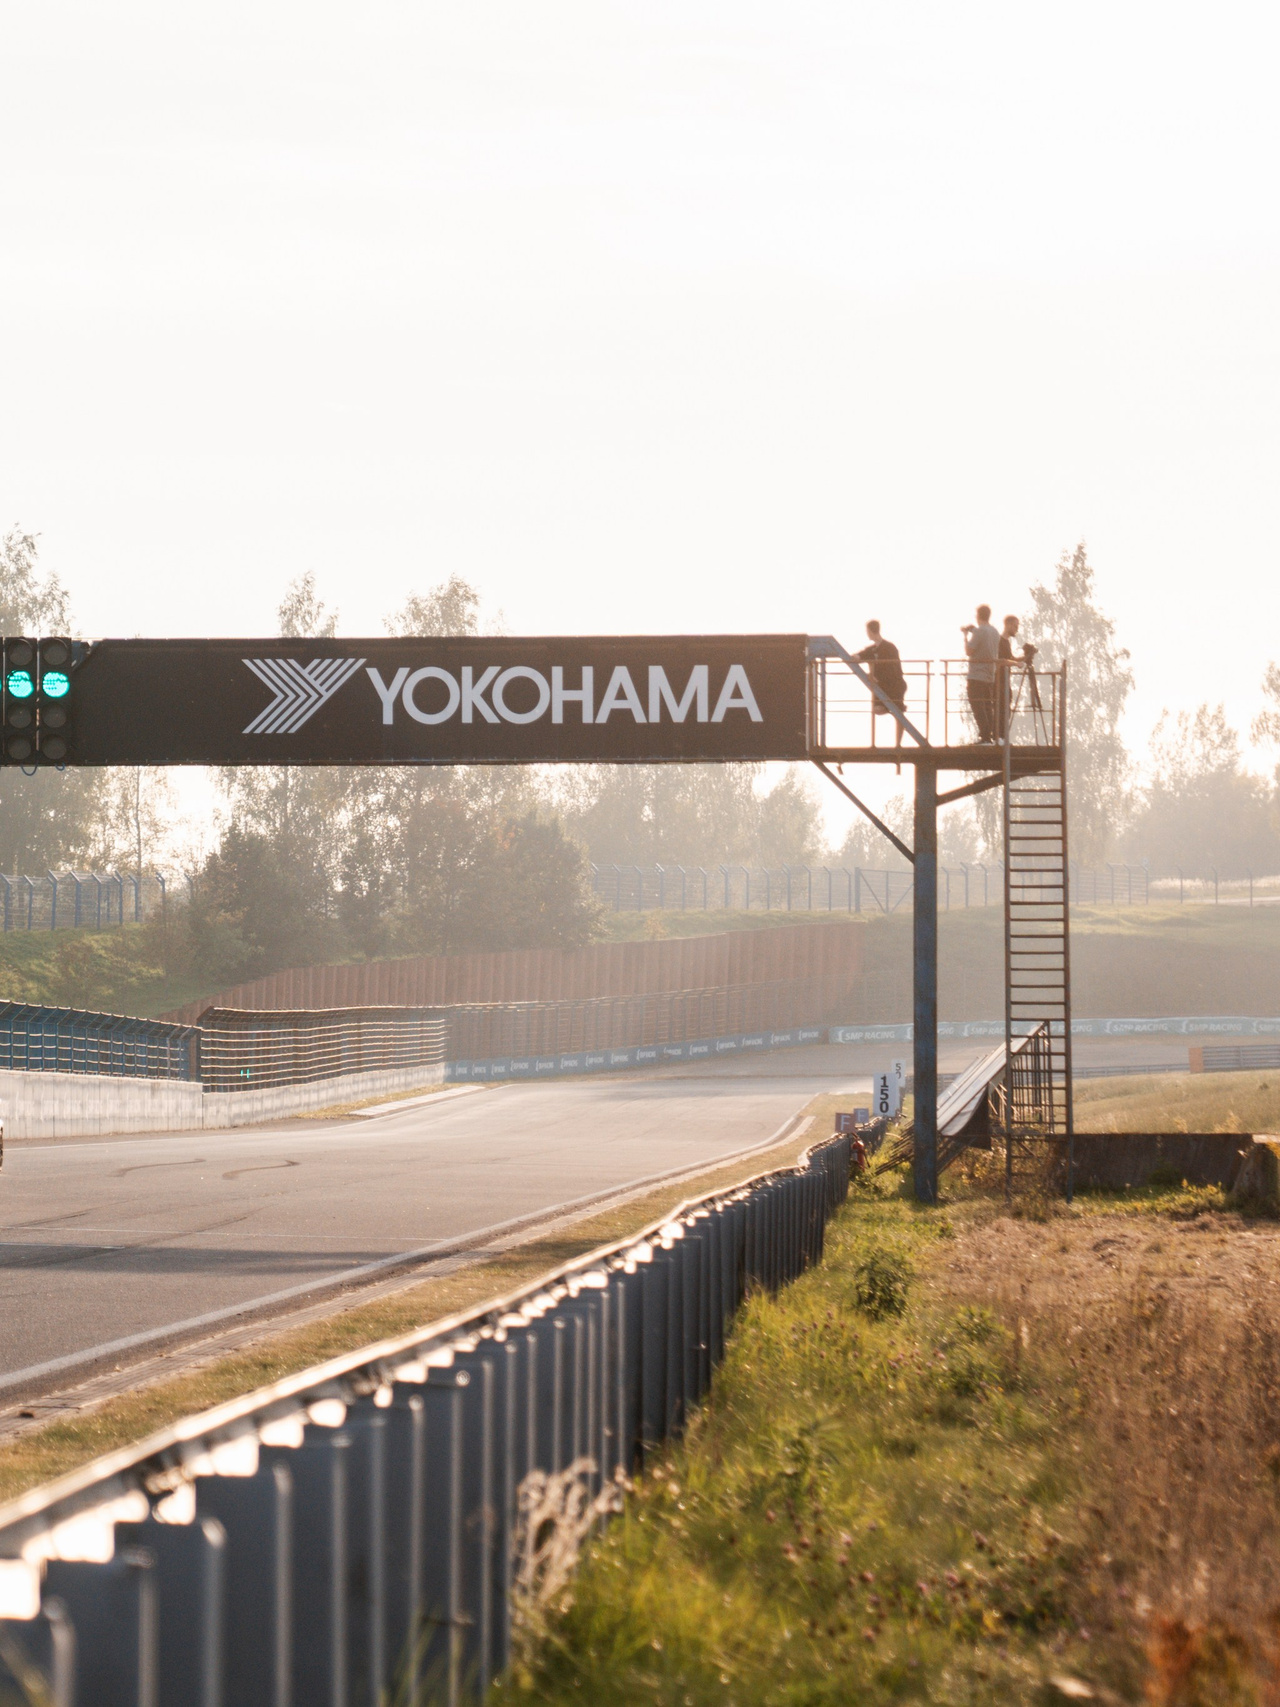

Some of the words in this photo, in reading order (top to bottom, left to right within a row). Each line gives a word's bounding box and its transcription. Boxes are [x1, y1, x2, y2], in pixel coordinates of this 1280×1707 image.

[366, 664, 763, 726] YOKOHAMA
[988, 1026, 1018, 1035] RACG
[1058, 1025, 1093, 1033] RCING
[845, 1032, 863, 1041] SMP
[864, 1031, 895, 1039] RACING
[880, 1075, 889, 1113] 150
[841, 1114, 851, 1131] F
